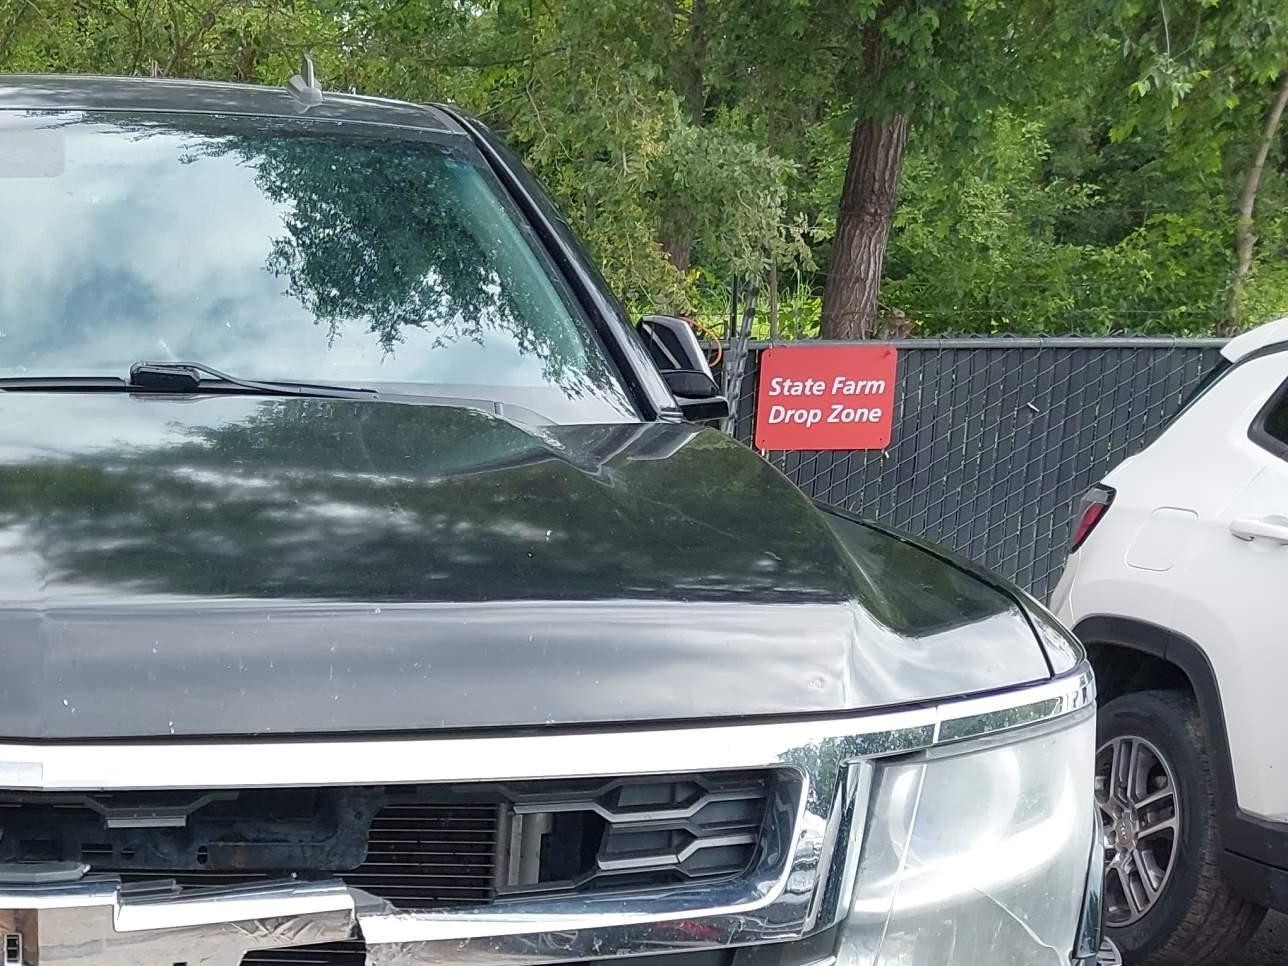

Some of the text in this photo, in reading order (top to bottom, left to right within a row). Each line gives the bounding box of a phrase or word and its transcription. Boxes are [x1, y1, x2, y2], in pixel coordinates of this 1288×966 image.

[768, 376, 886, 396] State Farm
[768, 405, 882, 428] Drop Zone
